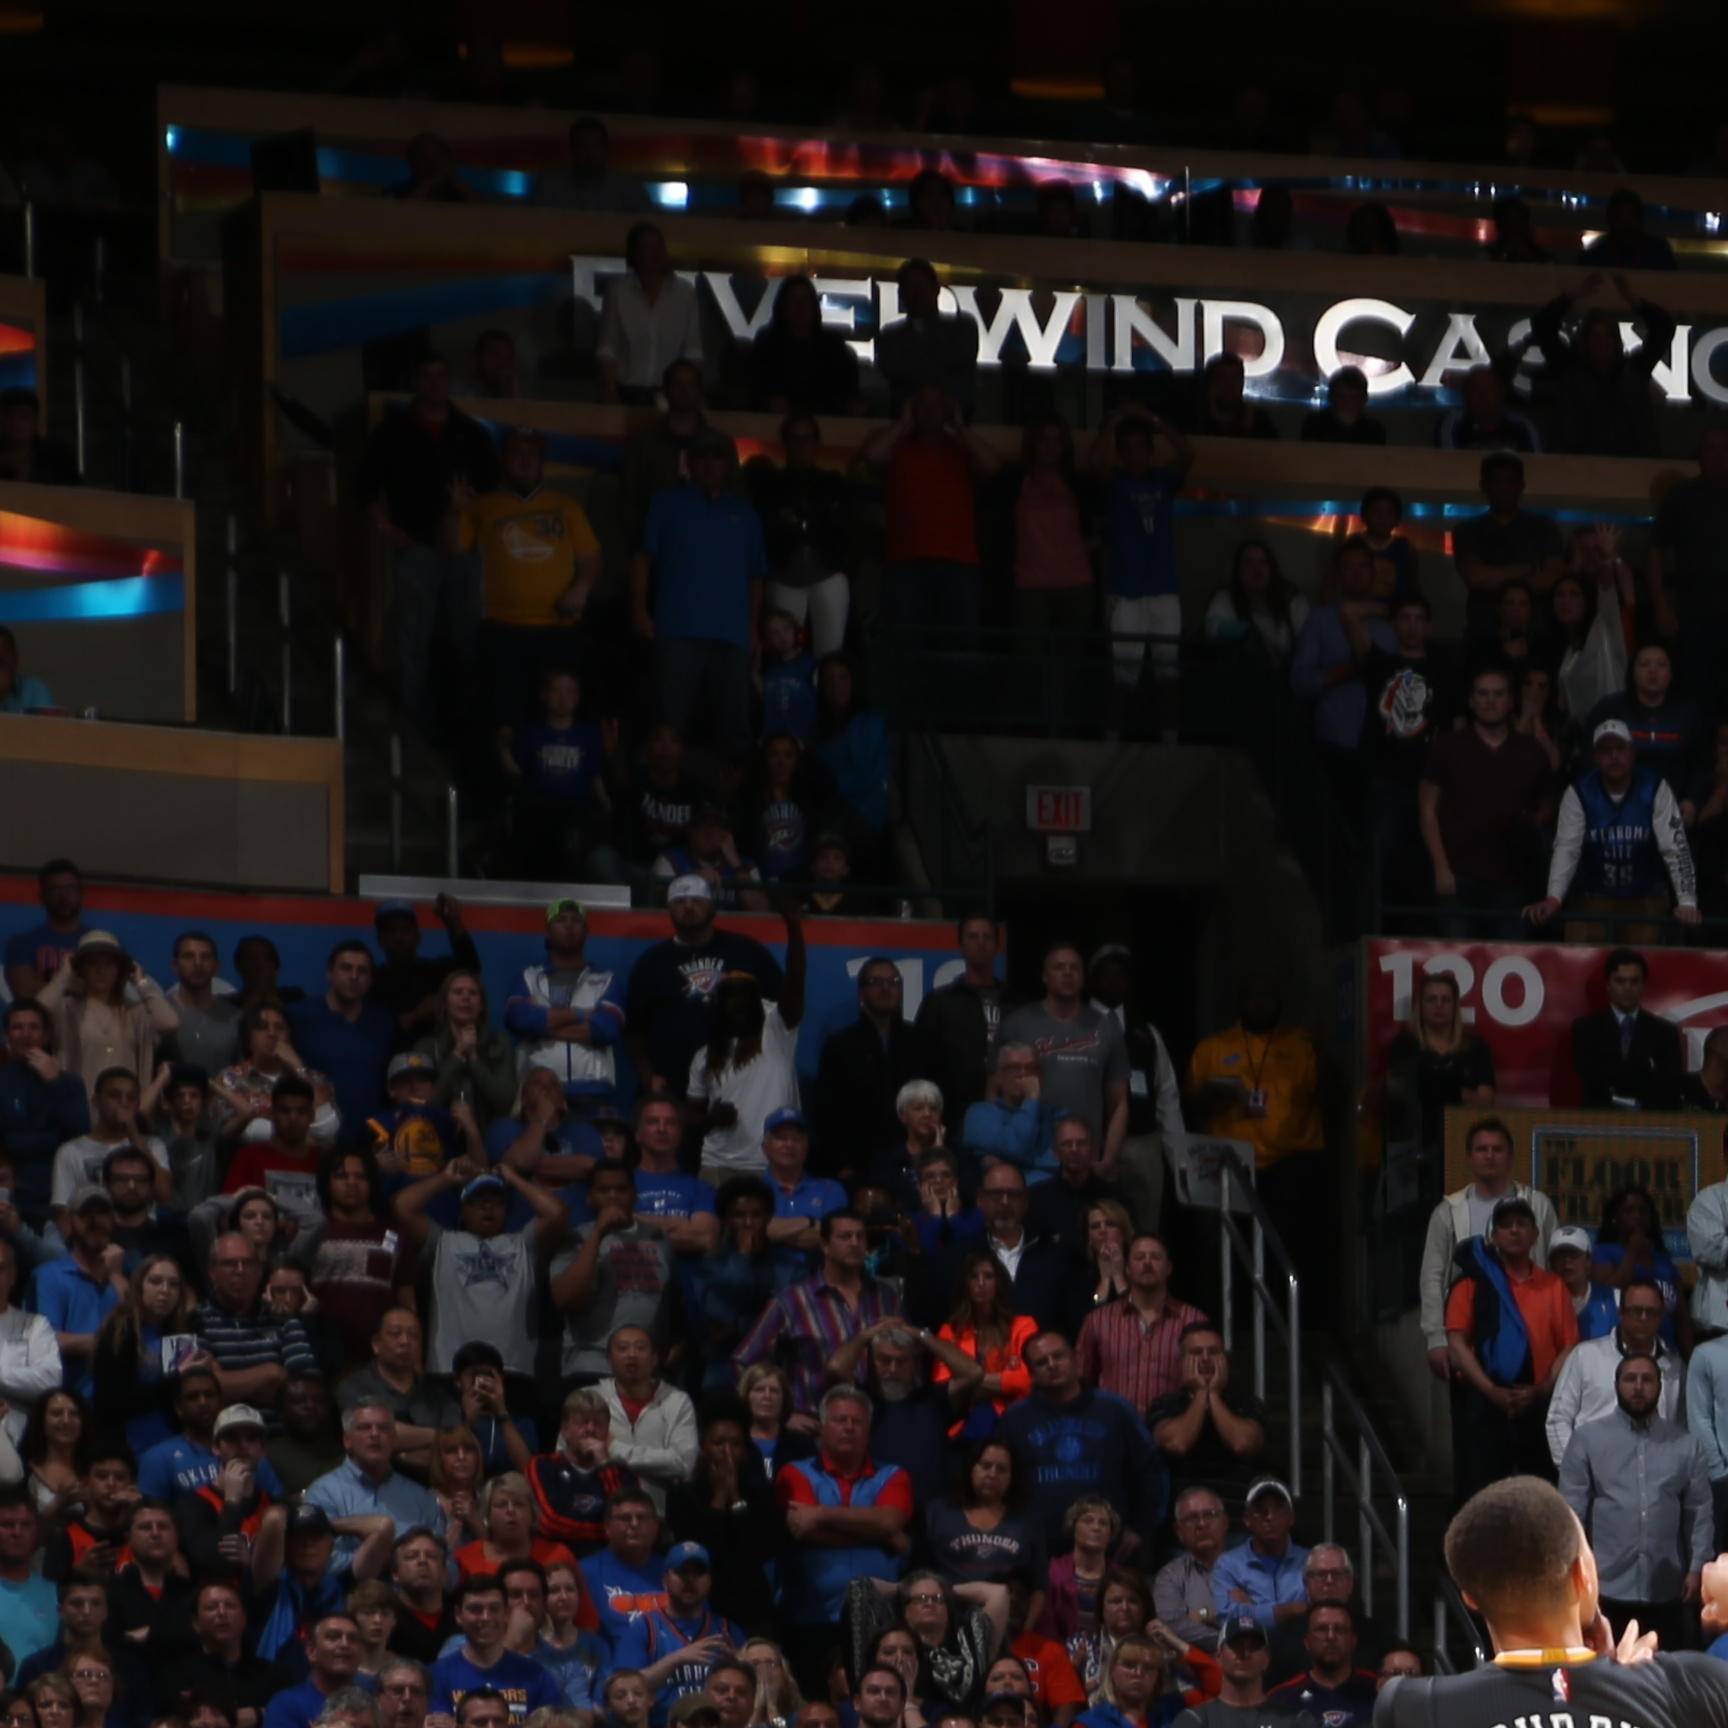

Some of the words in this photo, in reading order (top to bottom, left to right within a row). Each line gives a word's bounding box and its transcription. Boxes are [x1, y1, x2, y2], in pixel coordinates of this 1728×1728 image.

[1037, 792, 1085, 825] EXIT
[177, 1465, 220, 1490] OKLA
[949, 1534, 1021, 1555] THUNDER
